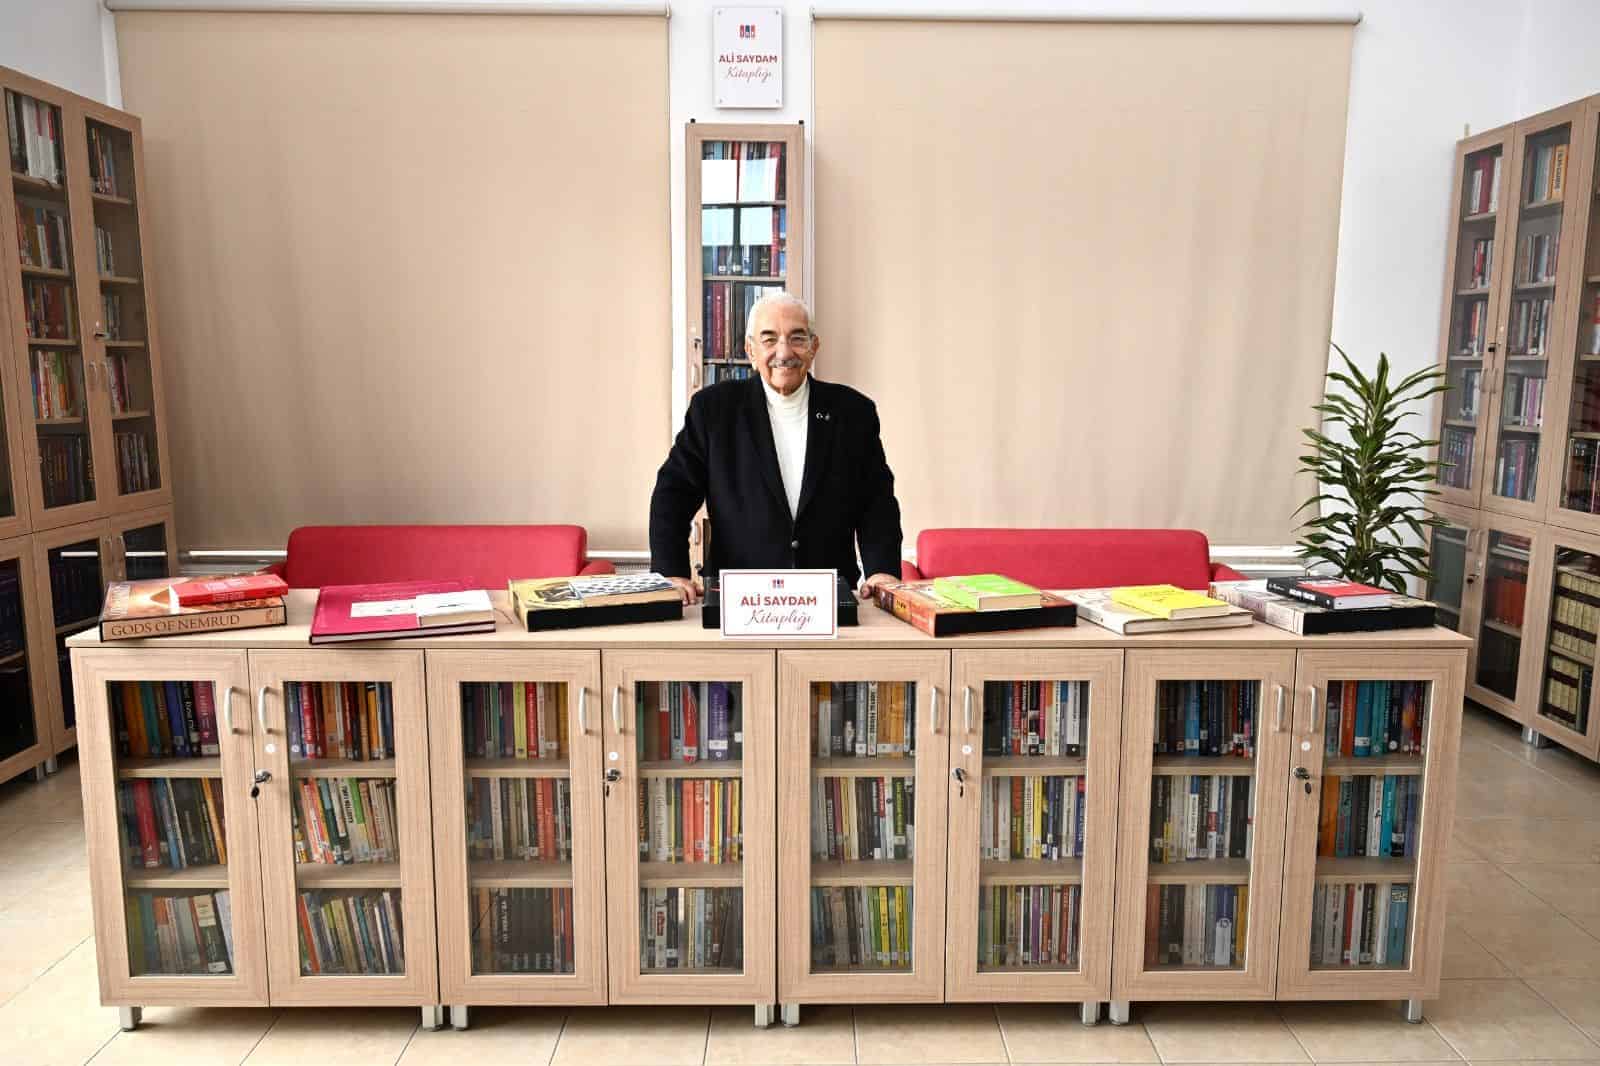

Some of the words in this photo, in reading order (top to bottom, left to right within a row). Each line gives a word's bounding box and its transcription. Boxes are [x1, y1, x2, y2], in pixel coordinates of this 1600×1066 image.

[719, 51, 735, 63] ALİ
[736, 54, 778, 63] SAYDAM
[741, 593, 761, 606] ALİ
[763, 595, 817, 606] SAYDAM
[111, 622, 152, 636] GODS
[155, 620, 173, 632] OF
[176, 614, 240, 630] NEMRUD
[744, 609, 813, 630] Kitaplığı
